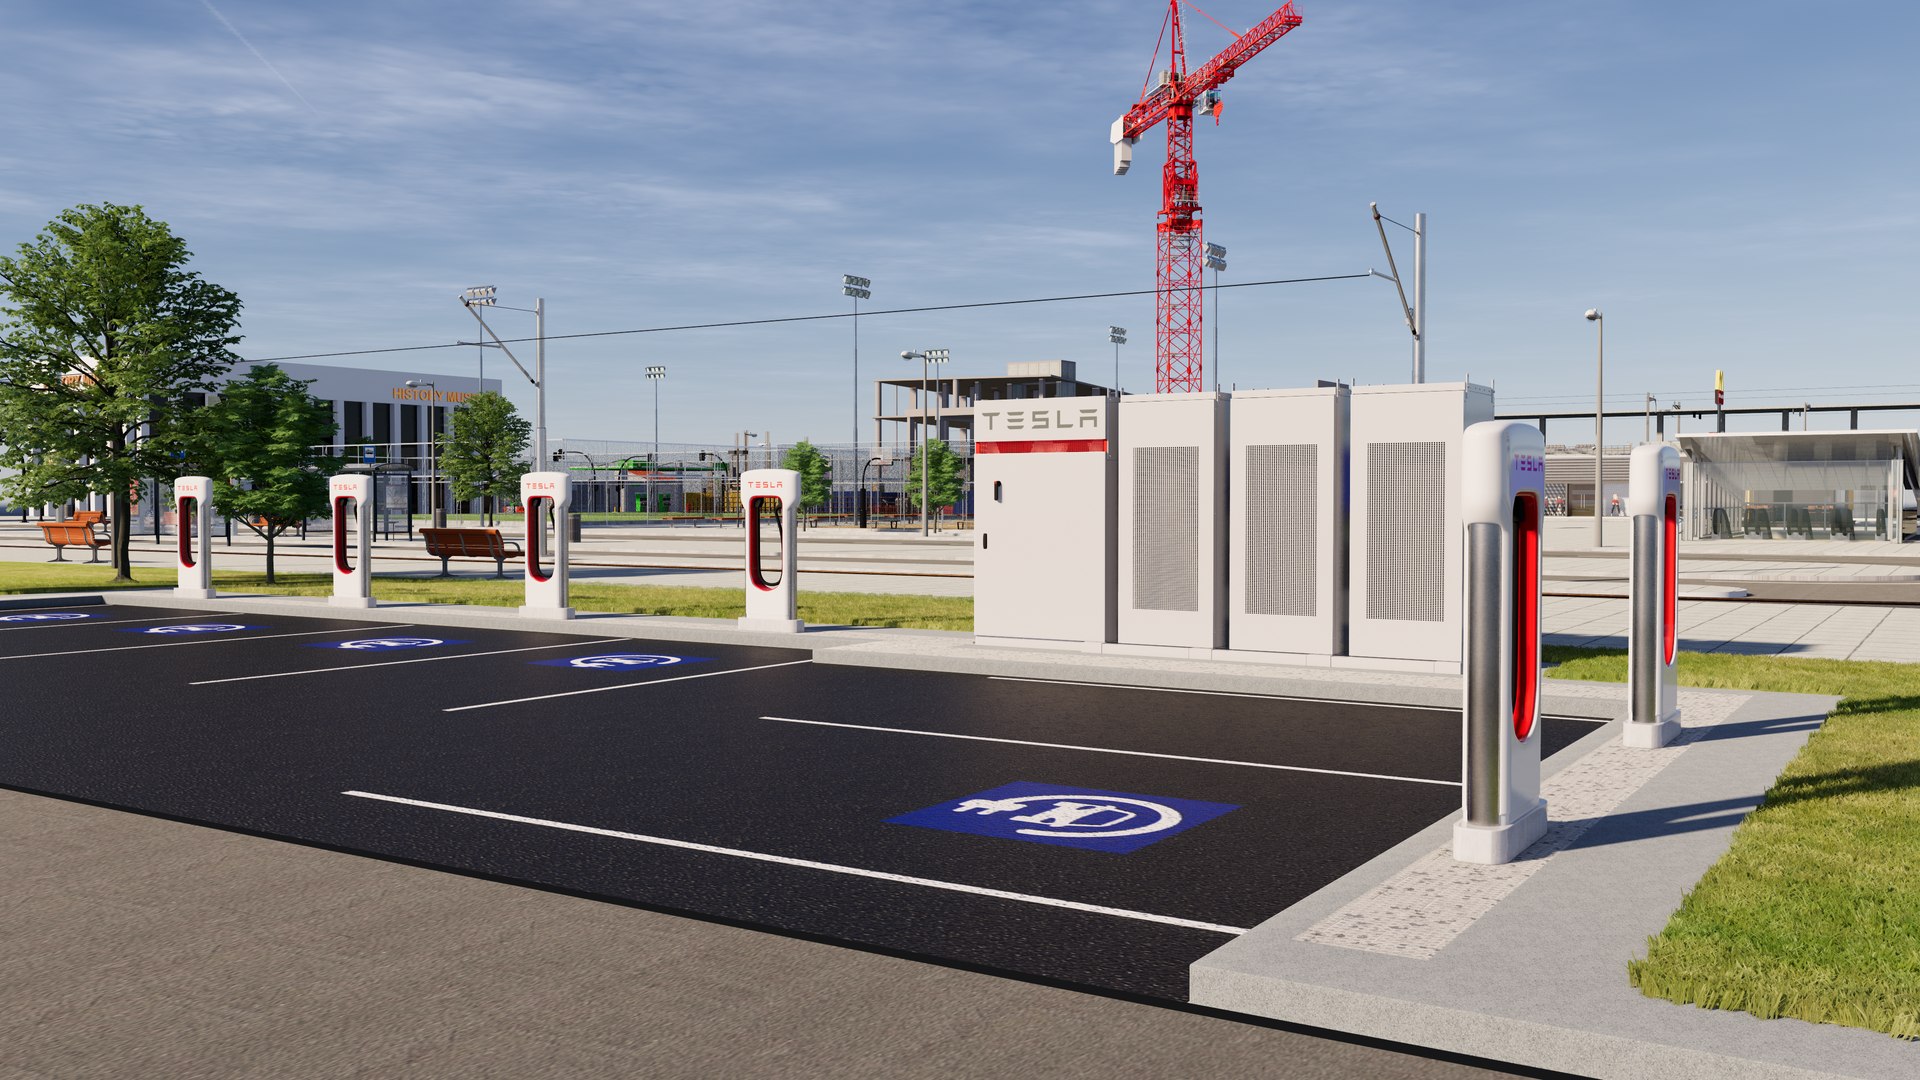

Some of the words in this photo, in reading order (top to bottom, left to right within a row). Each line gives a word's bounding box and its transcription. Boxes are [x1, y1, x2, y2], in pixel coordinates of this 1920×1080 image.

[447, 391, 480, 402] MUS
[981, 408, 1098, 430] TESLA
[1514, 453, 1544, 472] TESLA
[526, 482, 555, 490] TESLA
[747, 481, 783, 489] TESLA
